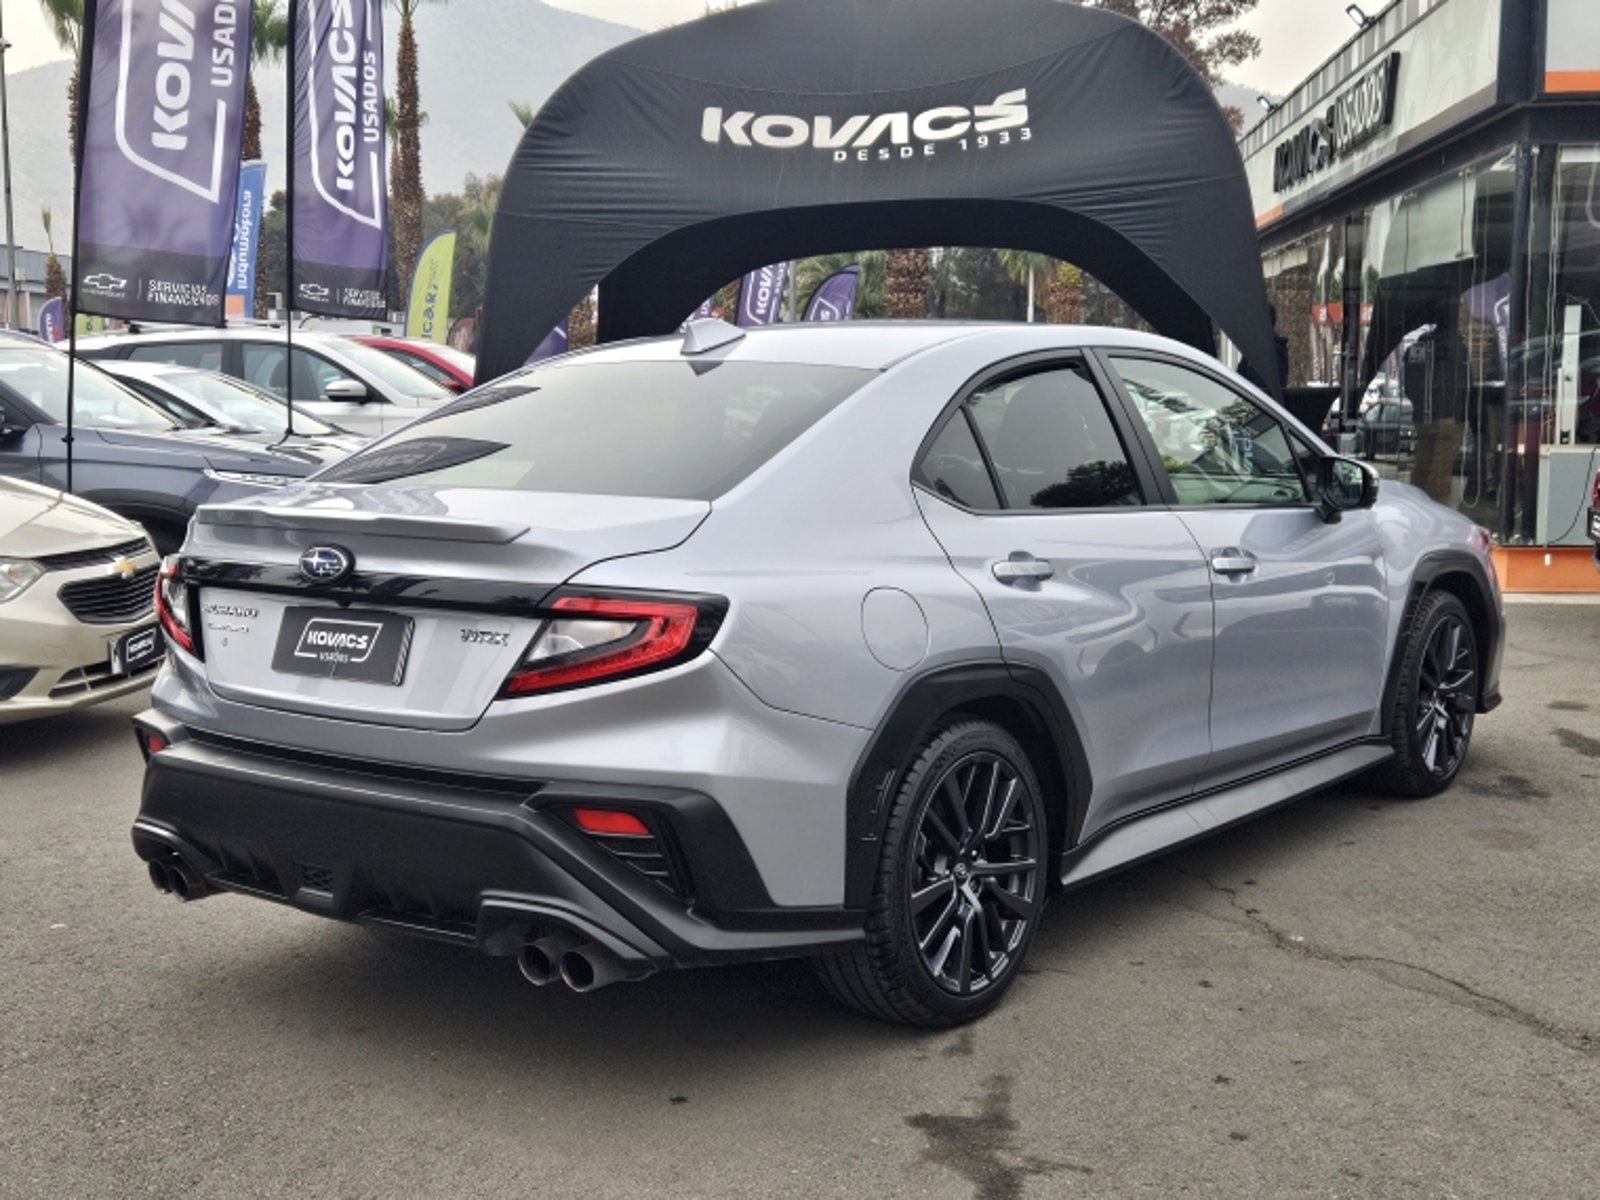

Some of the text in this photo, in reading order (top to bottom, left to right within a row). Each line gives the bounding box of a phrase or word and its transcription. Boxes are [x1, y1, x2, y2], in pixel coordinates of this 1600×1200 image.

[210, 0, 237, 87] USAD
[363, 51, 380, 143] USADOS
[700, 87, 1029, 149] KOVACS
[833, 127, 1032, 163] DESDE 1933
[306, 630, 369, 650] KOVACS
